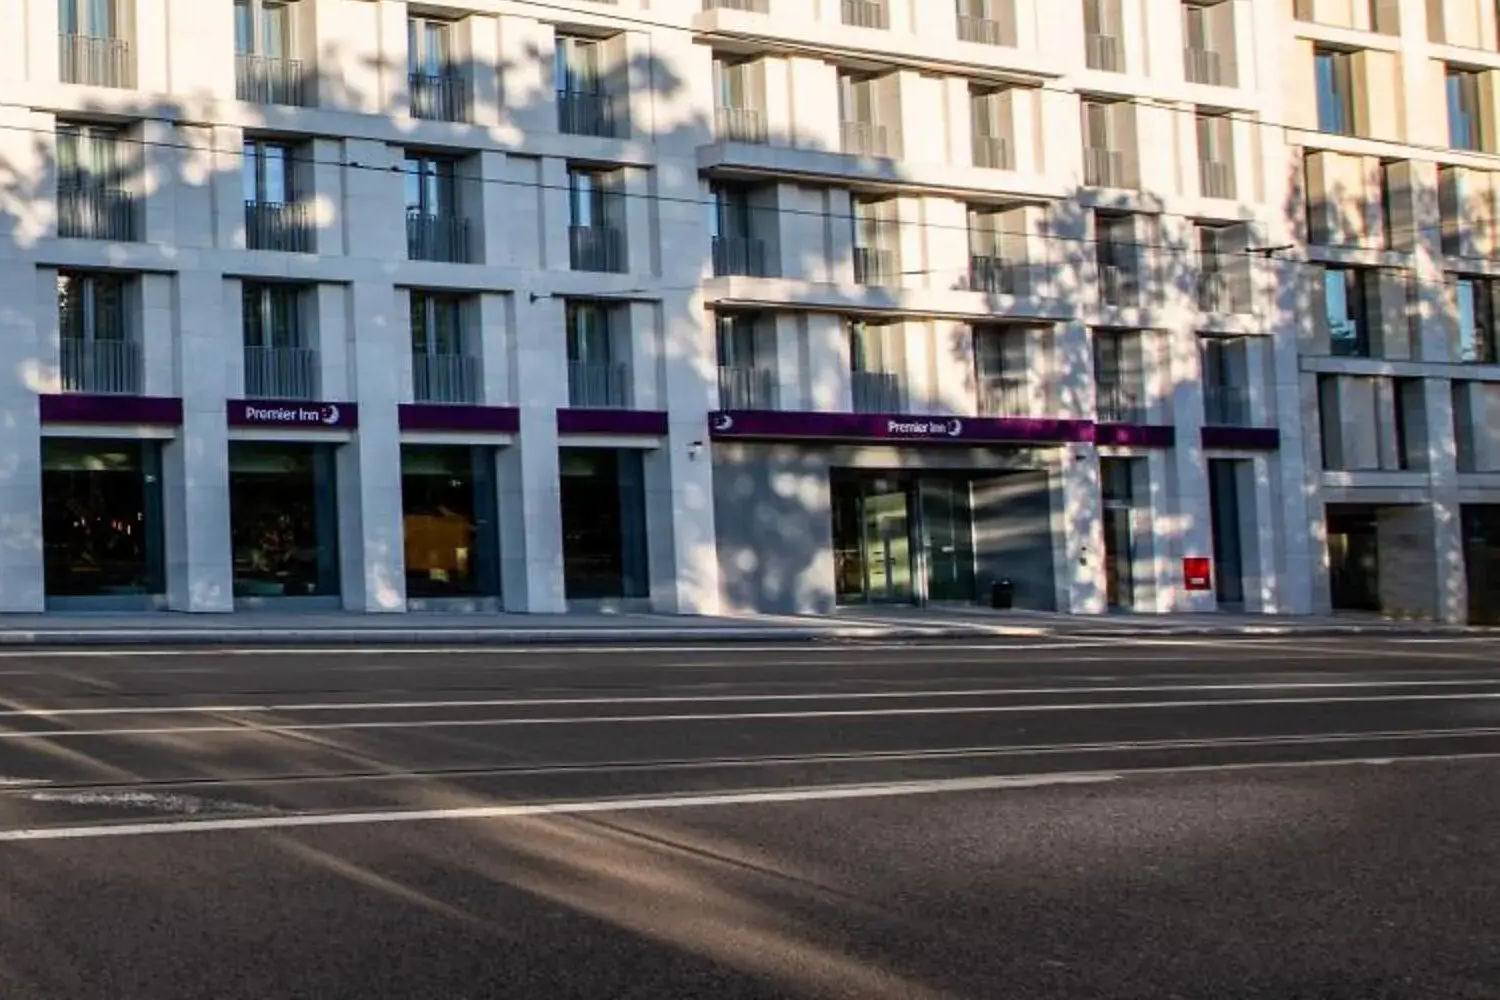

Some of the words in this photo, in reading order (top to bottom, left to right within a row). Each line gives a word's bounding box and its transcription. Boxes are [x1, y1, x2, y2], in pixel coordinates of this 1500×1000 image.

[245, 406, 297, 420] Premier
[300, 407, 319, 420] Inn
[888, 420, 928, 433] Premier
[930, 421, 946, 433] Inn
